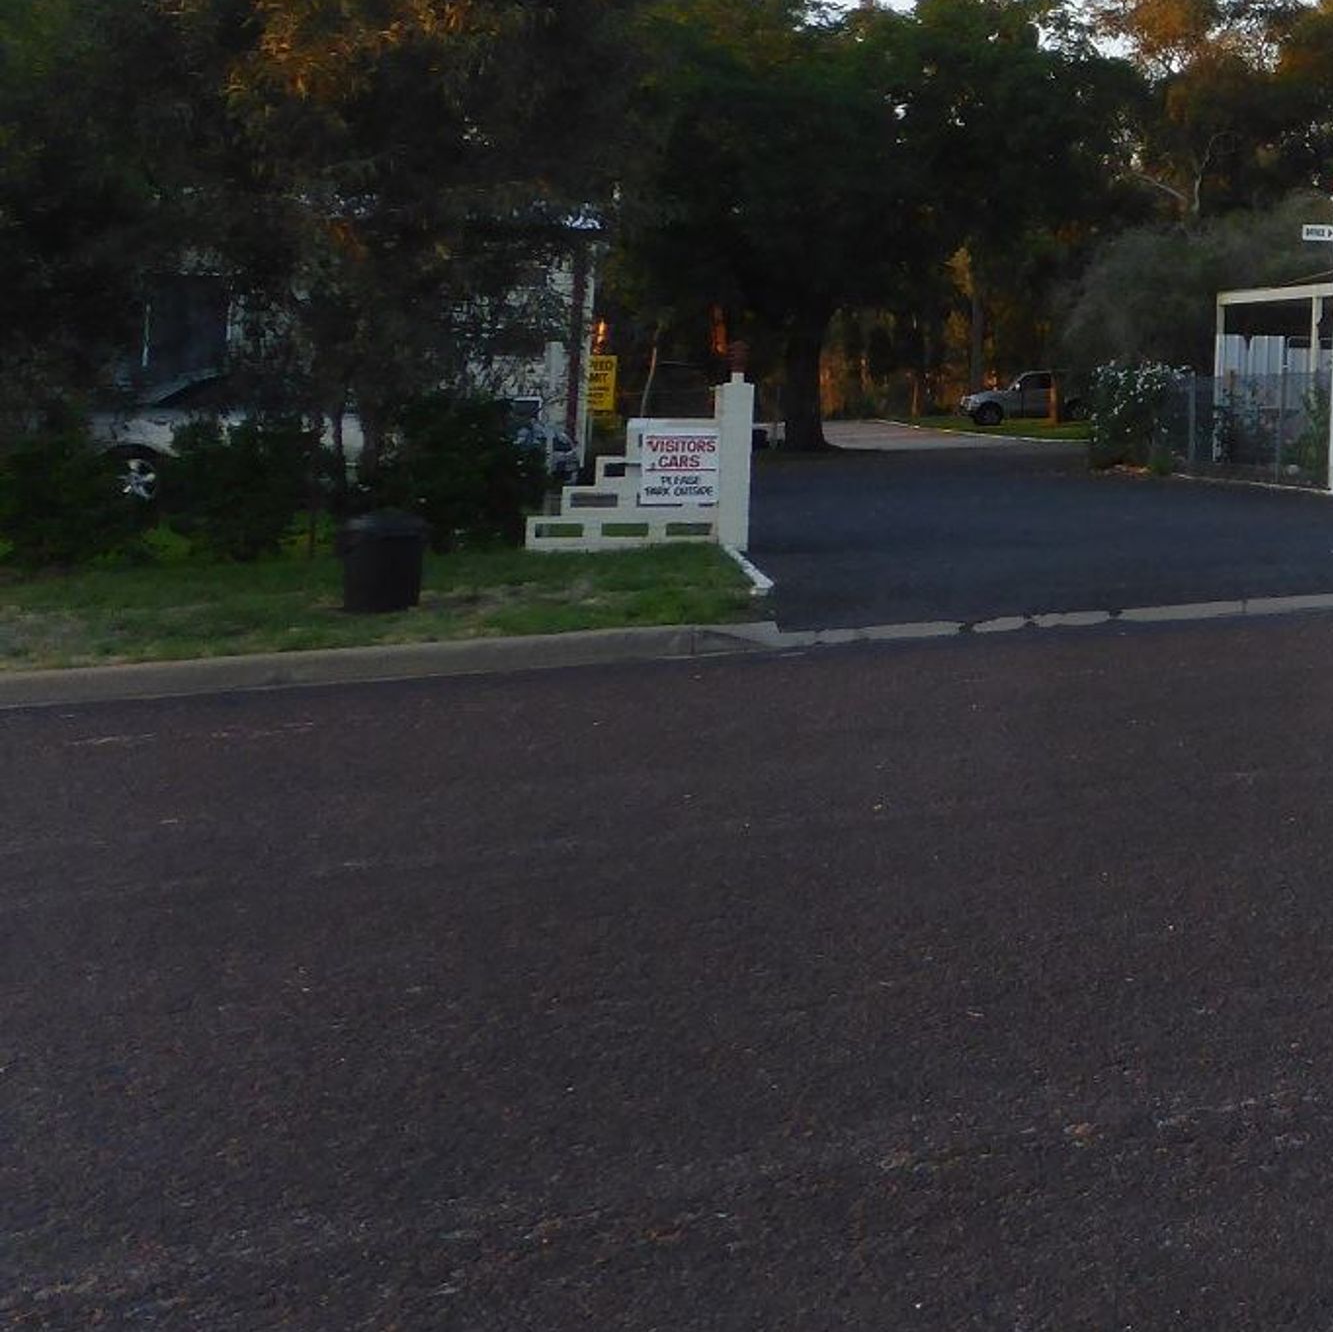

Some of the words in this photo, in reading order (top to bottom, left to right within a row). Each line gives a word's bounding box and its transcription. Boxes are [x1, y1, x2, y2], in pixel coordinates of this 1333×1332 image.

[647, 439, 716, 453] VISITORS
[658, 454, 700, 468] CARS
[661, 475, 700, 485] PLEASE
[645, 486, 670, 496] PARK
[674, 486, 714, 496] OUTSIDE
